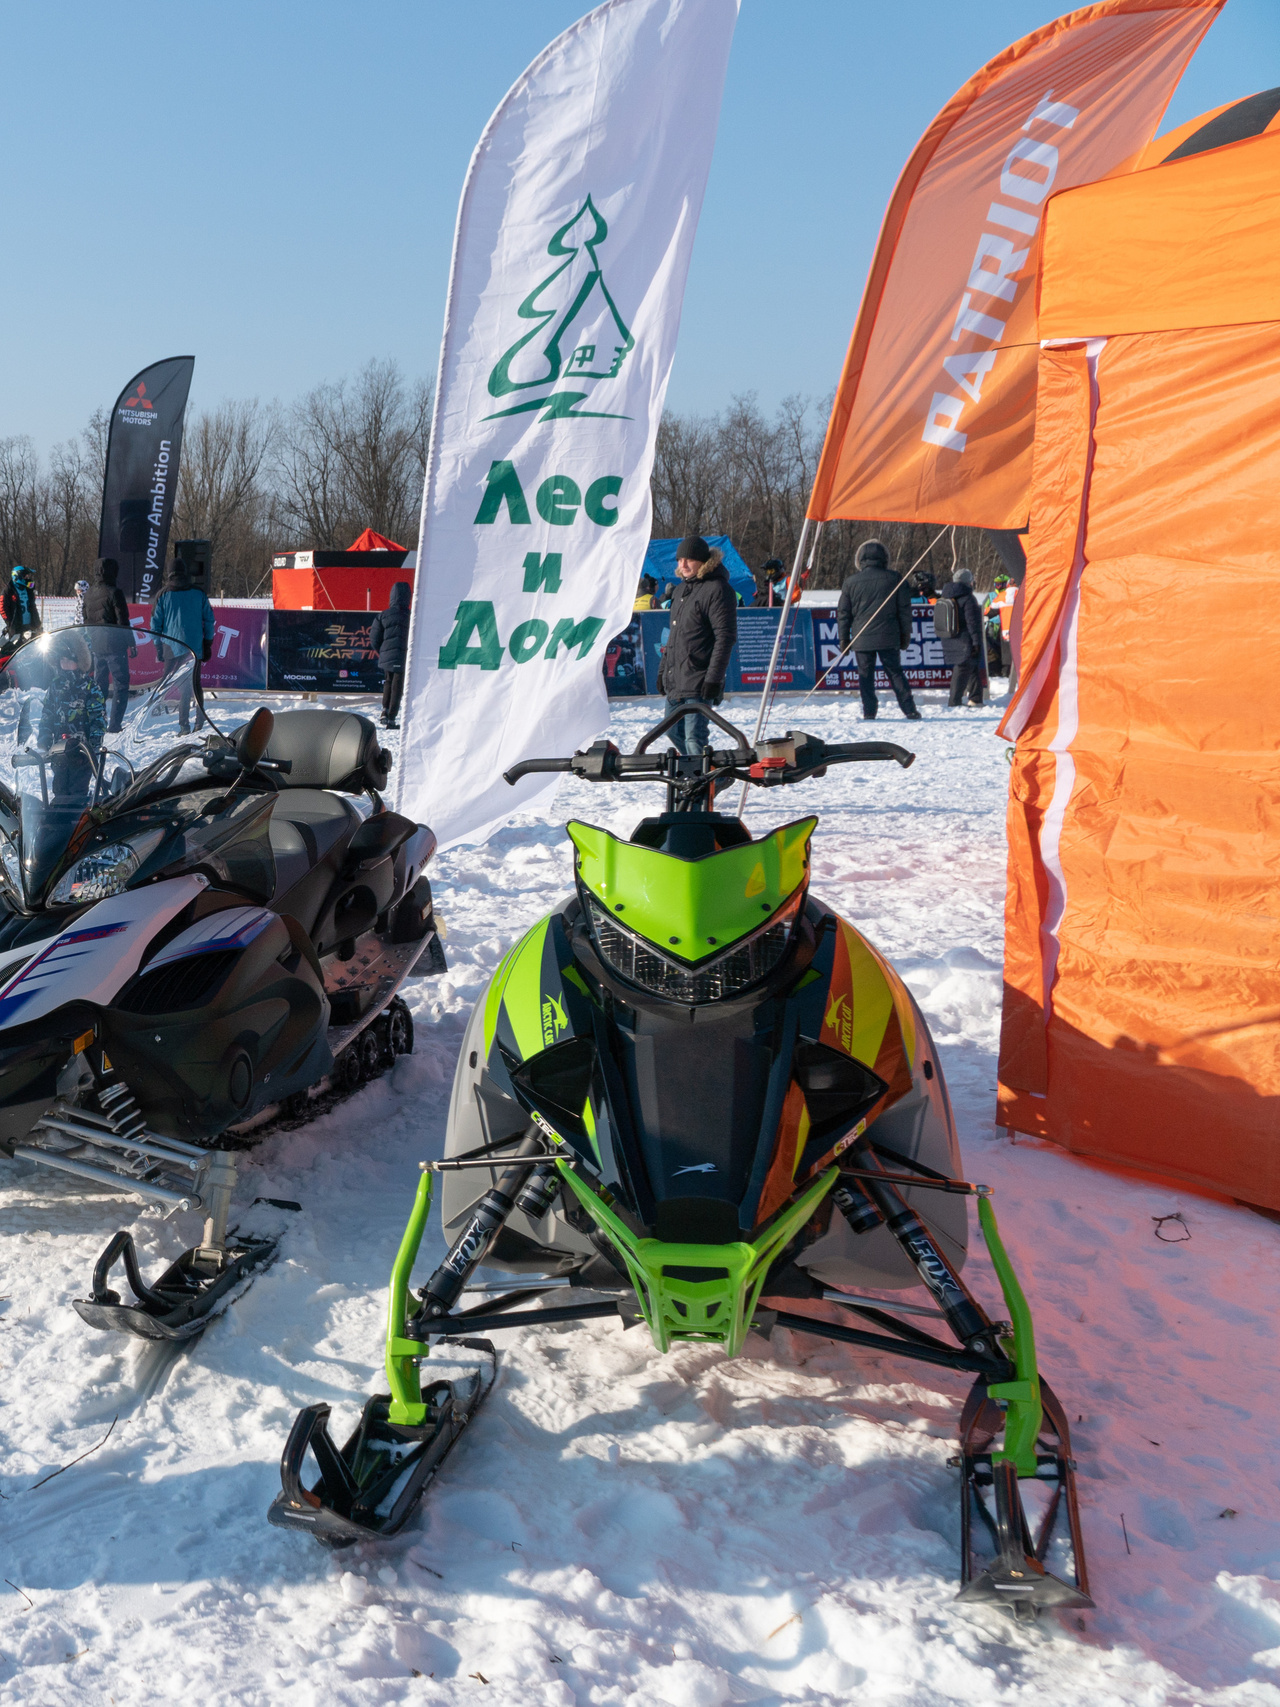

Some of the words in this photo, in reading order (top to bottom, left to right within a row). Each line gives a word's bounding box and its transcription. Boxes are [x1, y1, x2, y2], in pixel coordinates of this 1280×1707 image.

[921, 88, 1080, 452] PATRIOT
[118, 408, 157, 419] MITSUBISHI
[122, 416, 151, 425] MOTORS
[147, 439, 171, 526] Ambition
[473, 460, 624, 527] Лес
[145, 528, 159, 570] your
[136, 573, 153, 605] rive
[437, 600, 606, 671] Дом
[283, 673, 317, 681] МОСКВА
[70, 926, 129, 944] VENTURE
[542, 1002, 553, 1031] ARCTIC
[841, 1002, 852, 1021] CAT
[544, 1029, 554, 1046] CAT
[841, 1017, 852, 1052] ARCTIC
[448, 1217, 486, 1276] FOX
[907, 1239, 961, 1292] FOX
